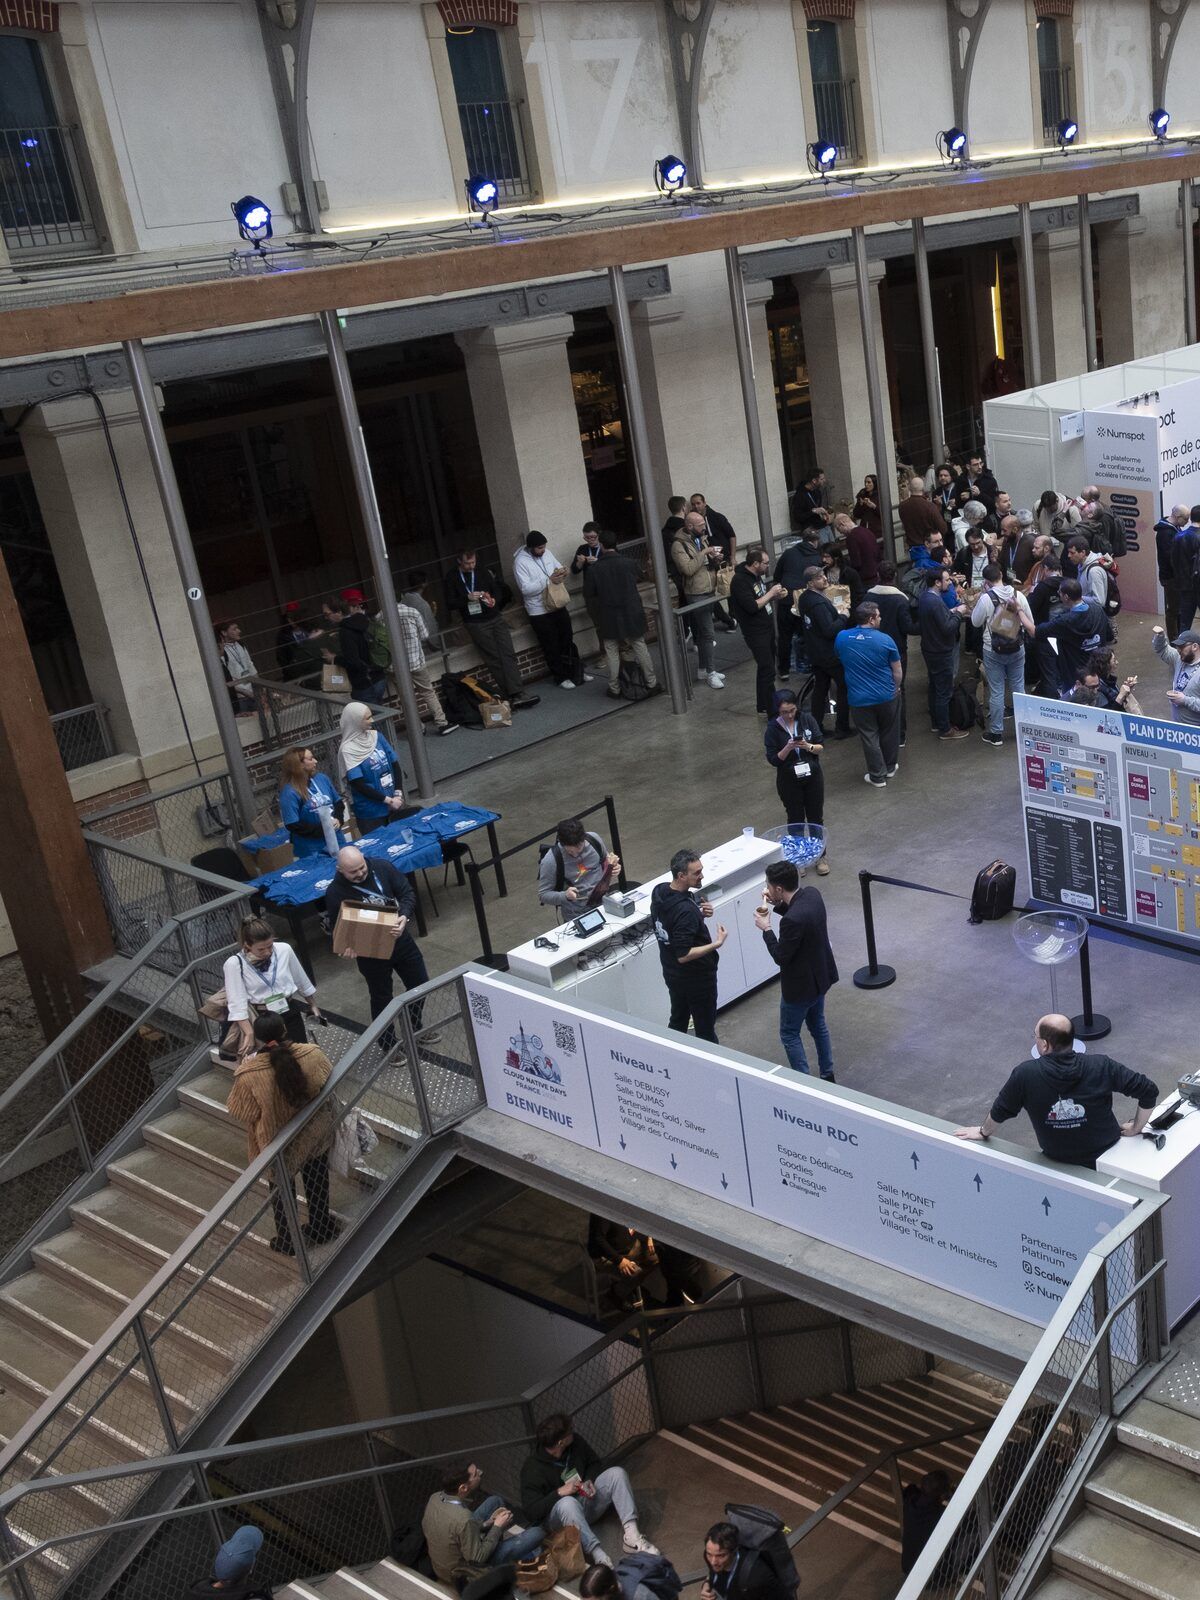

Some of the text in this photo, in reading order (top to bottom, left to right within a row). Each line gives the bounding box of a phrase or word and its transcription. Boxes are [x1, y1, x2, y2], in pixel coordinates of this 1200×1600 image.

[1106, 428, 1145, 441] Numspot
[1110, 454, 1141, 464] plateforme
[1161, 446, 1178, 461] me
[1180, 440, 1193, 455] de
[1107, 463, 1135, 471] confiance
[1040, 706, 1088, 720] CLOUD NATIVE DAYS
[1021, 726, 1033, 735] REZ
[1034, 728, 1042, 737] DE
[1129, 722, 1154, 739] PLAN
[1125, 746, 1157, 759] NIVEAU -1
[610, 1049, 671, 1080] Niveau -1
[503, 1067, 568, 1097] CLOUD NATIVE DAYS
[516, 1081, 541, 1096] FRANCE
[614, 1072, 670, 1098] Salle DEBUSSY
[616, 1084, 665, 1108] Salle DUMAS
[506, 1092, 574, 1128] BIENVENUE
[618, 1095, 706, 1134] Partenaires Gold, Silver
[619, 1105, 665, 1129] & End users
[620, 1115, 719, 1159] Village des Communautés
[773, 1106, 859, 1147] Niveau RDC
[777, 1144, 854, 1179] Espace Dédicaces
[779, 1157, 814, 1177] Goodies
[780, 1168, 827, 1193] La Fresque
[789, 1181, 820, 1198] Chainguard
[877, 1180, 936, 1209] Salle MONET
[878, 1194, 924, 1217] Salle PIAF
[879, 1206, 890, 1216] La
[880, 1217, 911, 1235] Village
[913, 1229, 934, 1245] Tosit
[937, 1239, 947, 1249] et
[950, 1243, 998, 1268] Ministères
[1021, 1233, 1078, 1261] Partenaires
[1022, 1245, 1065, 1268] Platinum
[1034, 1266, 1072, 1287] Scalew
